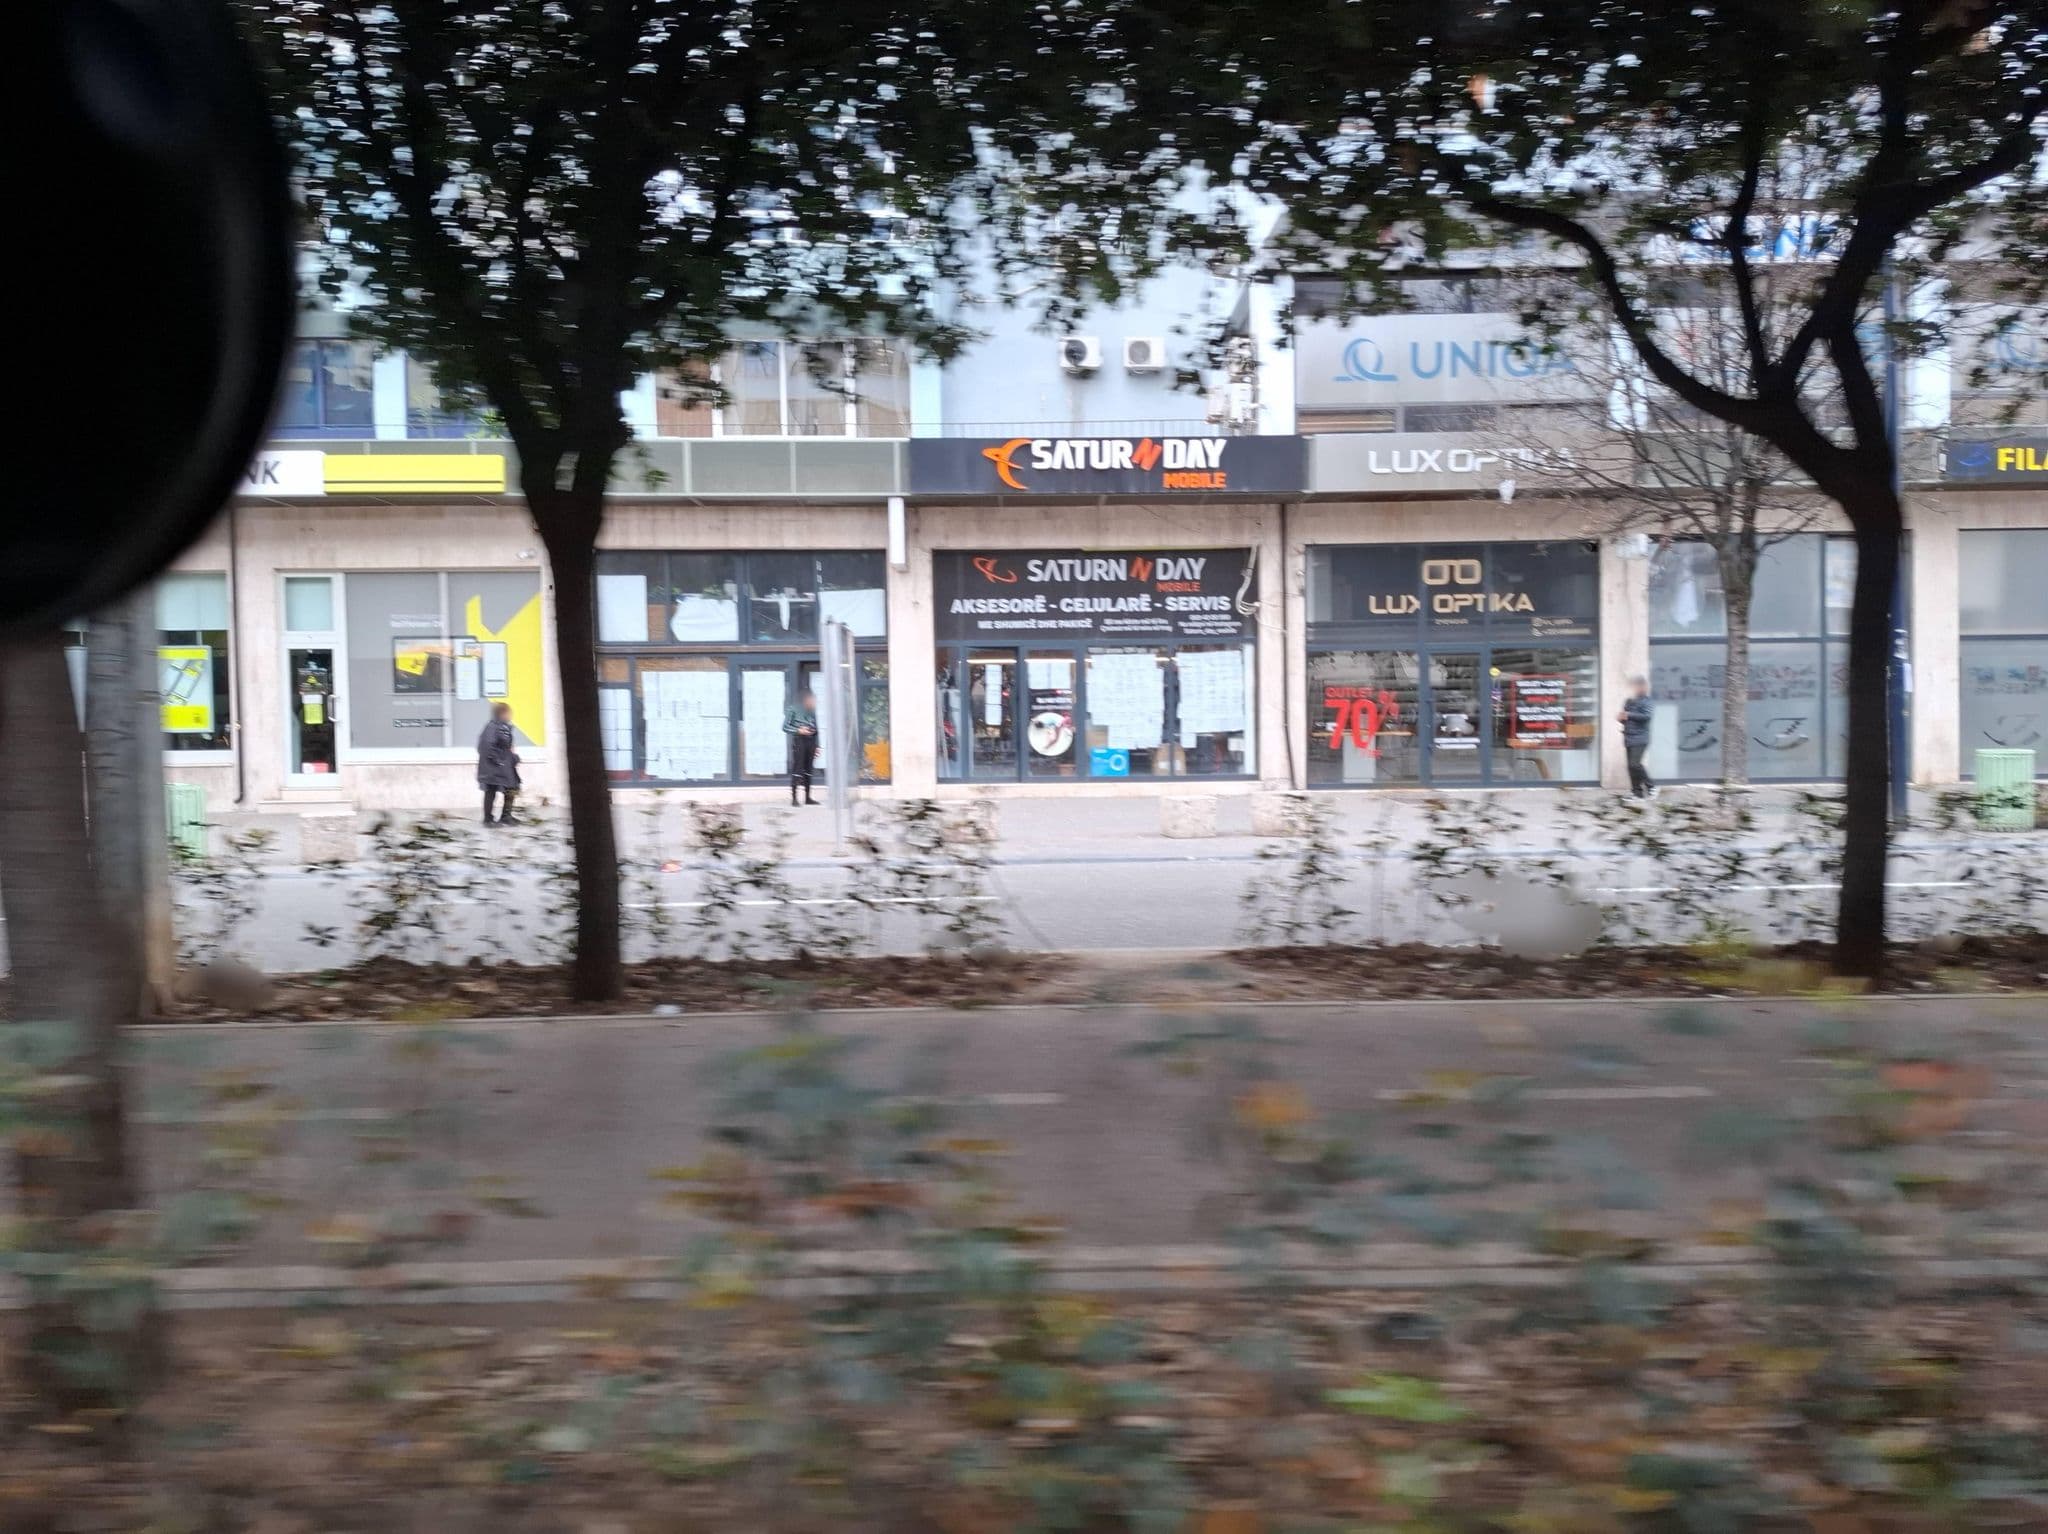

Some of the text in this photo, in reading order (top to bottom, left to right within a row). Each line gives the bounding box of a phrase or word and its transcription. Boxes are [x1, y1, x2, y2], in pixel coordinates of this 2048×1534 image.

[1368, 449, 1443, 474] LUX
[1996, 447, 2048, 471] FIL
[1163, 472, 1227, 489] MOBILE
[1027, 558, 1127, 583] SATURN
[1156, 557, 1207, 581] DAY
[1156, 581, 1201, 592] MOBILE
[950, 594, 1047, 614] AKSESORË
[1059, 594, 1152, 613] CELULARË
[1164, 595, 1232, 612] SERVIS
[1368, 591, 1535, 615] LUX OPTIKA
